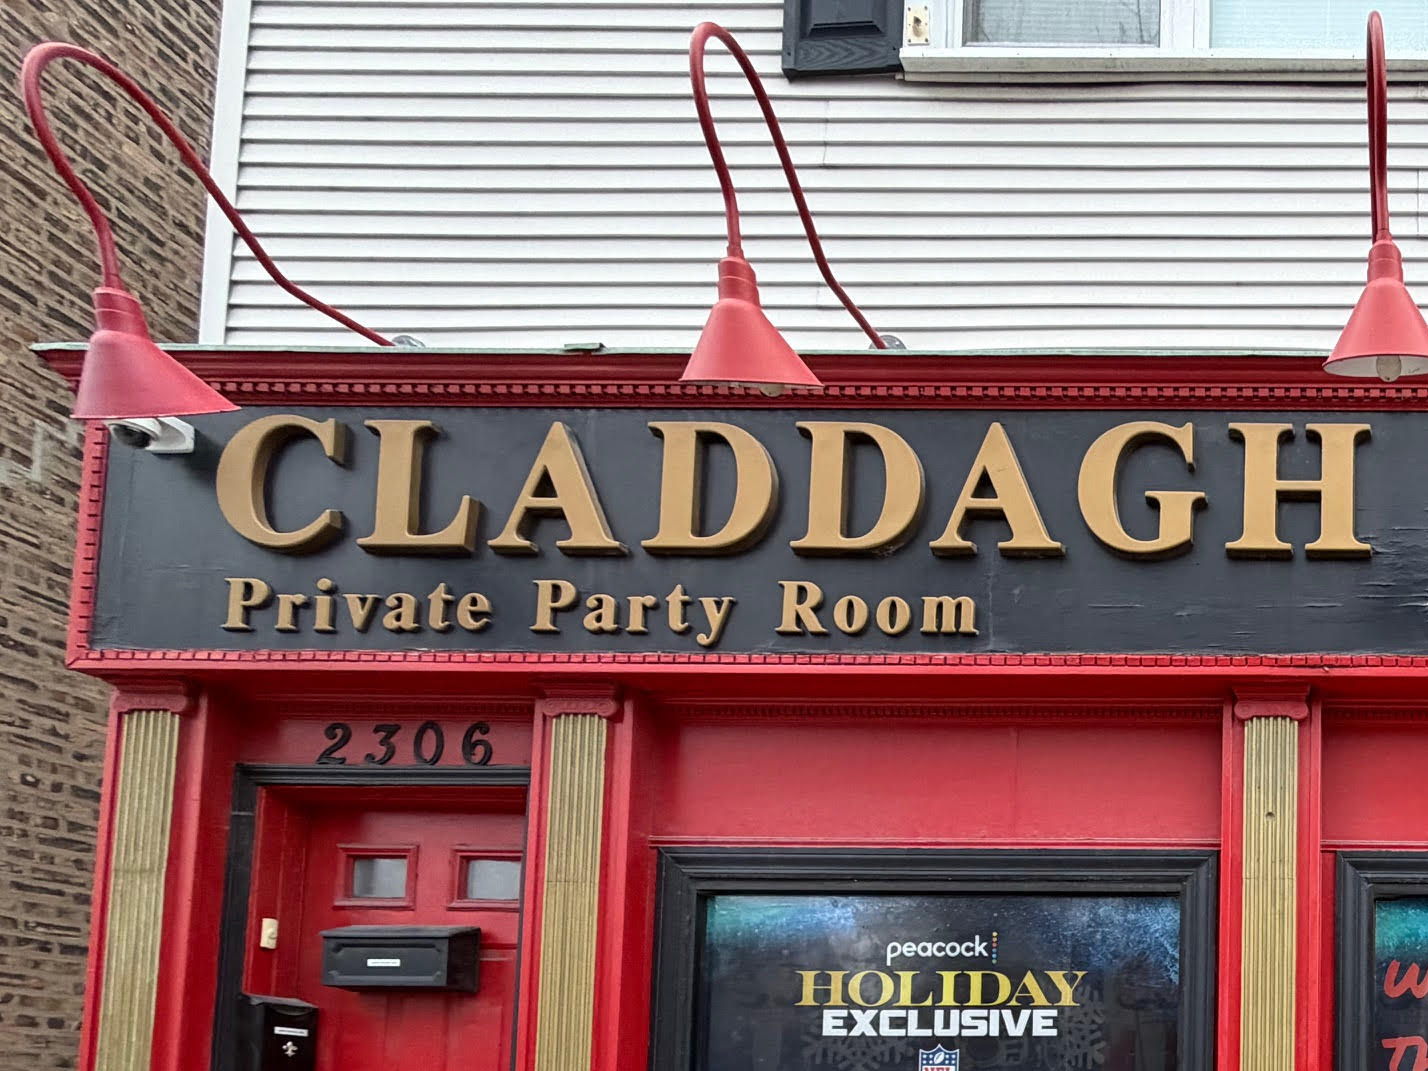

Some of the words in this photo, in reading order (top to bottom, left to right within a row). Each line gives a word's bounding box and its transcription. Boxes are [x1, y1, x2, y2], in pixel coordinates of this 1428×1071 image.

[215, 412, 1373, 559] CLADDAGH
[220, 577, 493, 633] Private
[529, 579, 737, 647] Party
[774, 580, 980, 636] Room
[315, 719, 494, 767] 2306
[886, 934, 989, 966] peacock
[794, 969, 1087, 1007] HOLIDAY
[821, 1009, 1058, 1038] EXCLUSIVE
